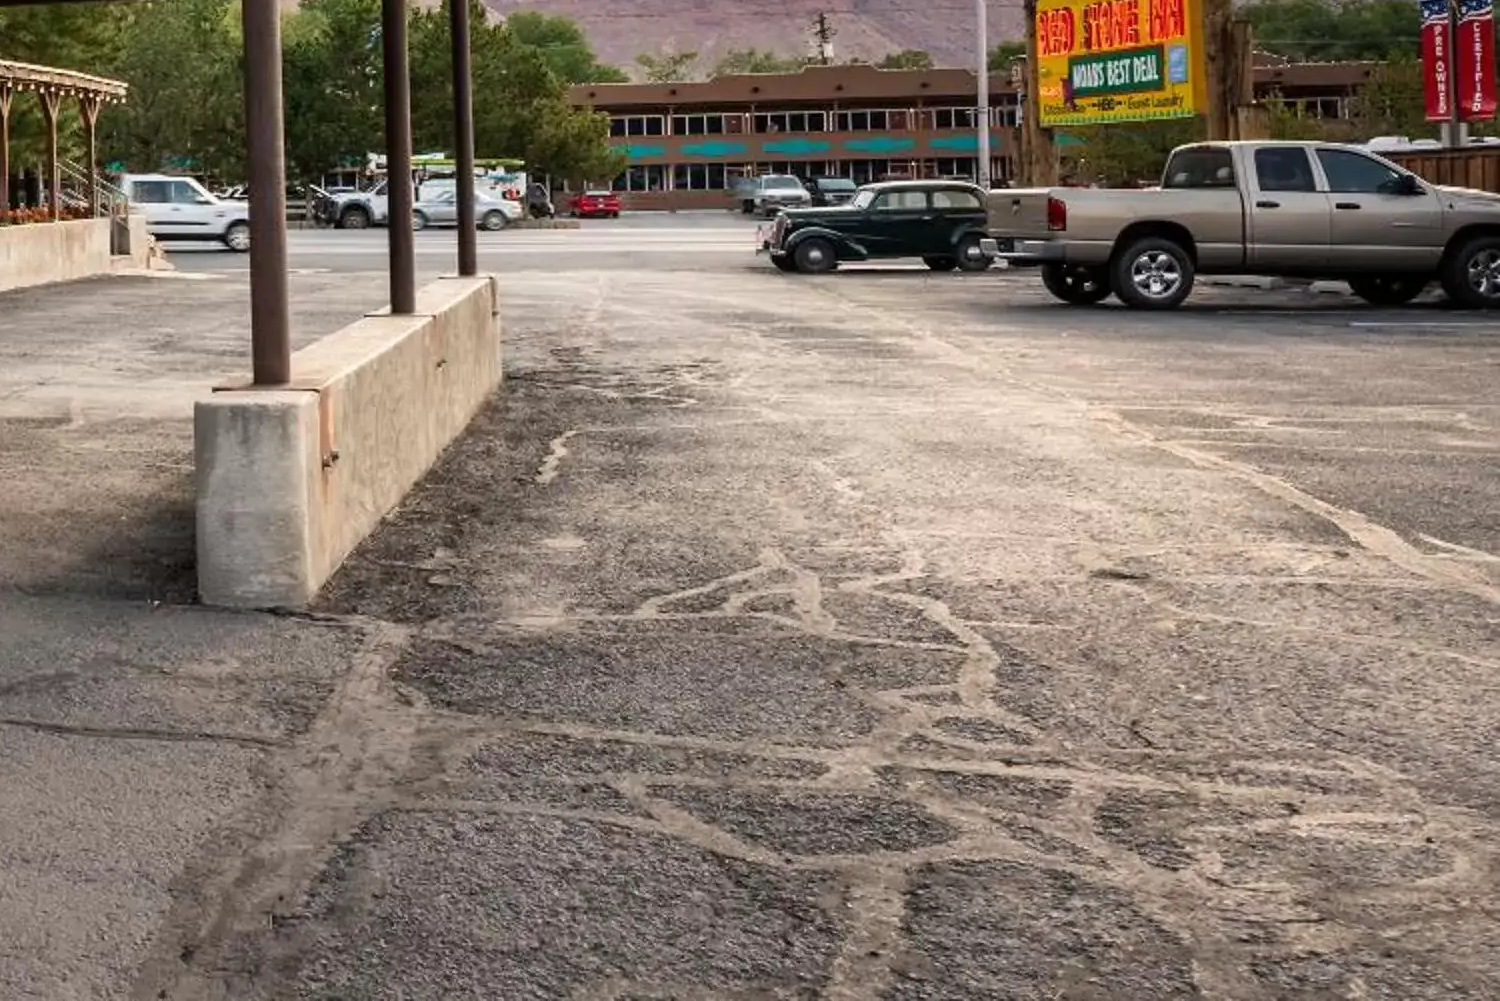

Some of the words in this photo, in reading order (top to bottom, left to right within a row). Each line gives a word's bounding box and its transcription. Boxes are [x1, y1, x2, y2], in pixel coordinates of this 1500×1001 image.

[1036, 8, 1075, 56] RED
[1107, 58, 1131, 86] BEST
[1132, 54, 1159, 83] DEAL
